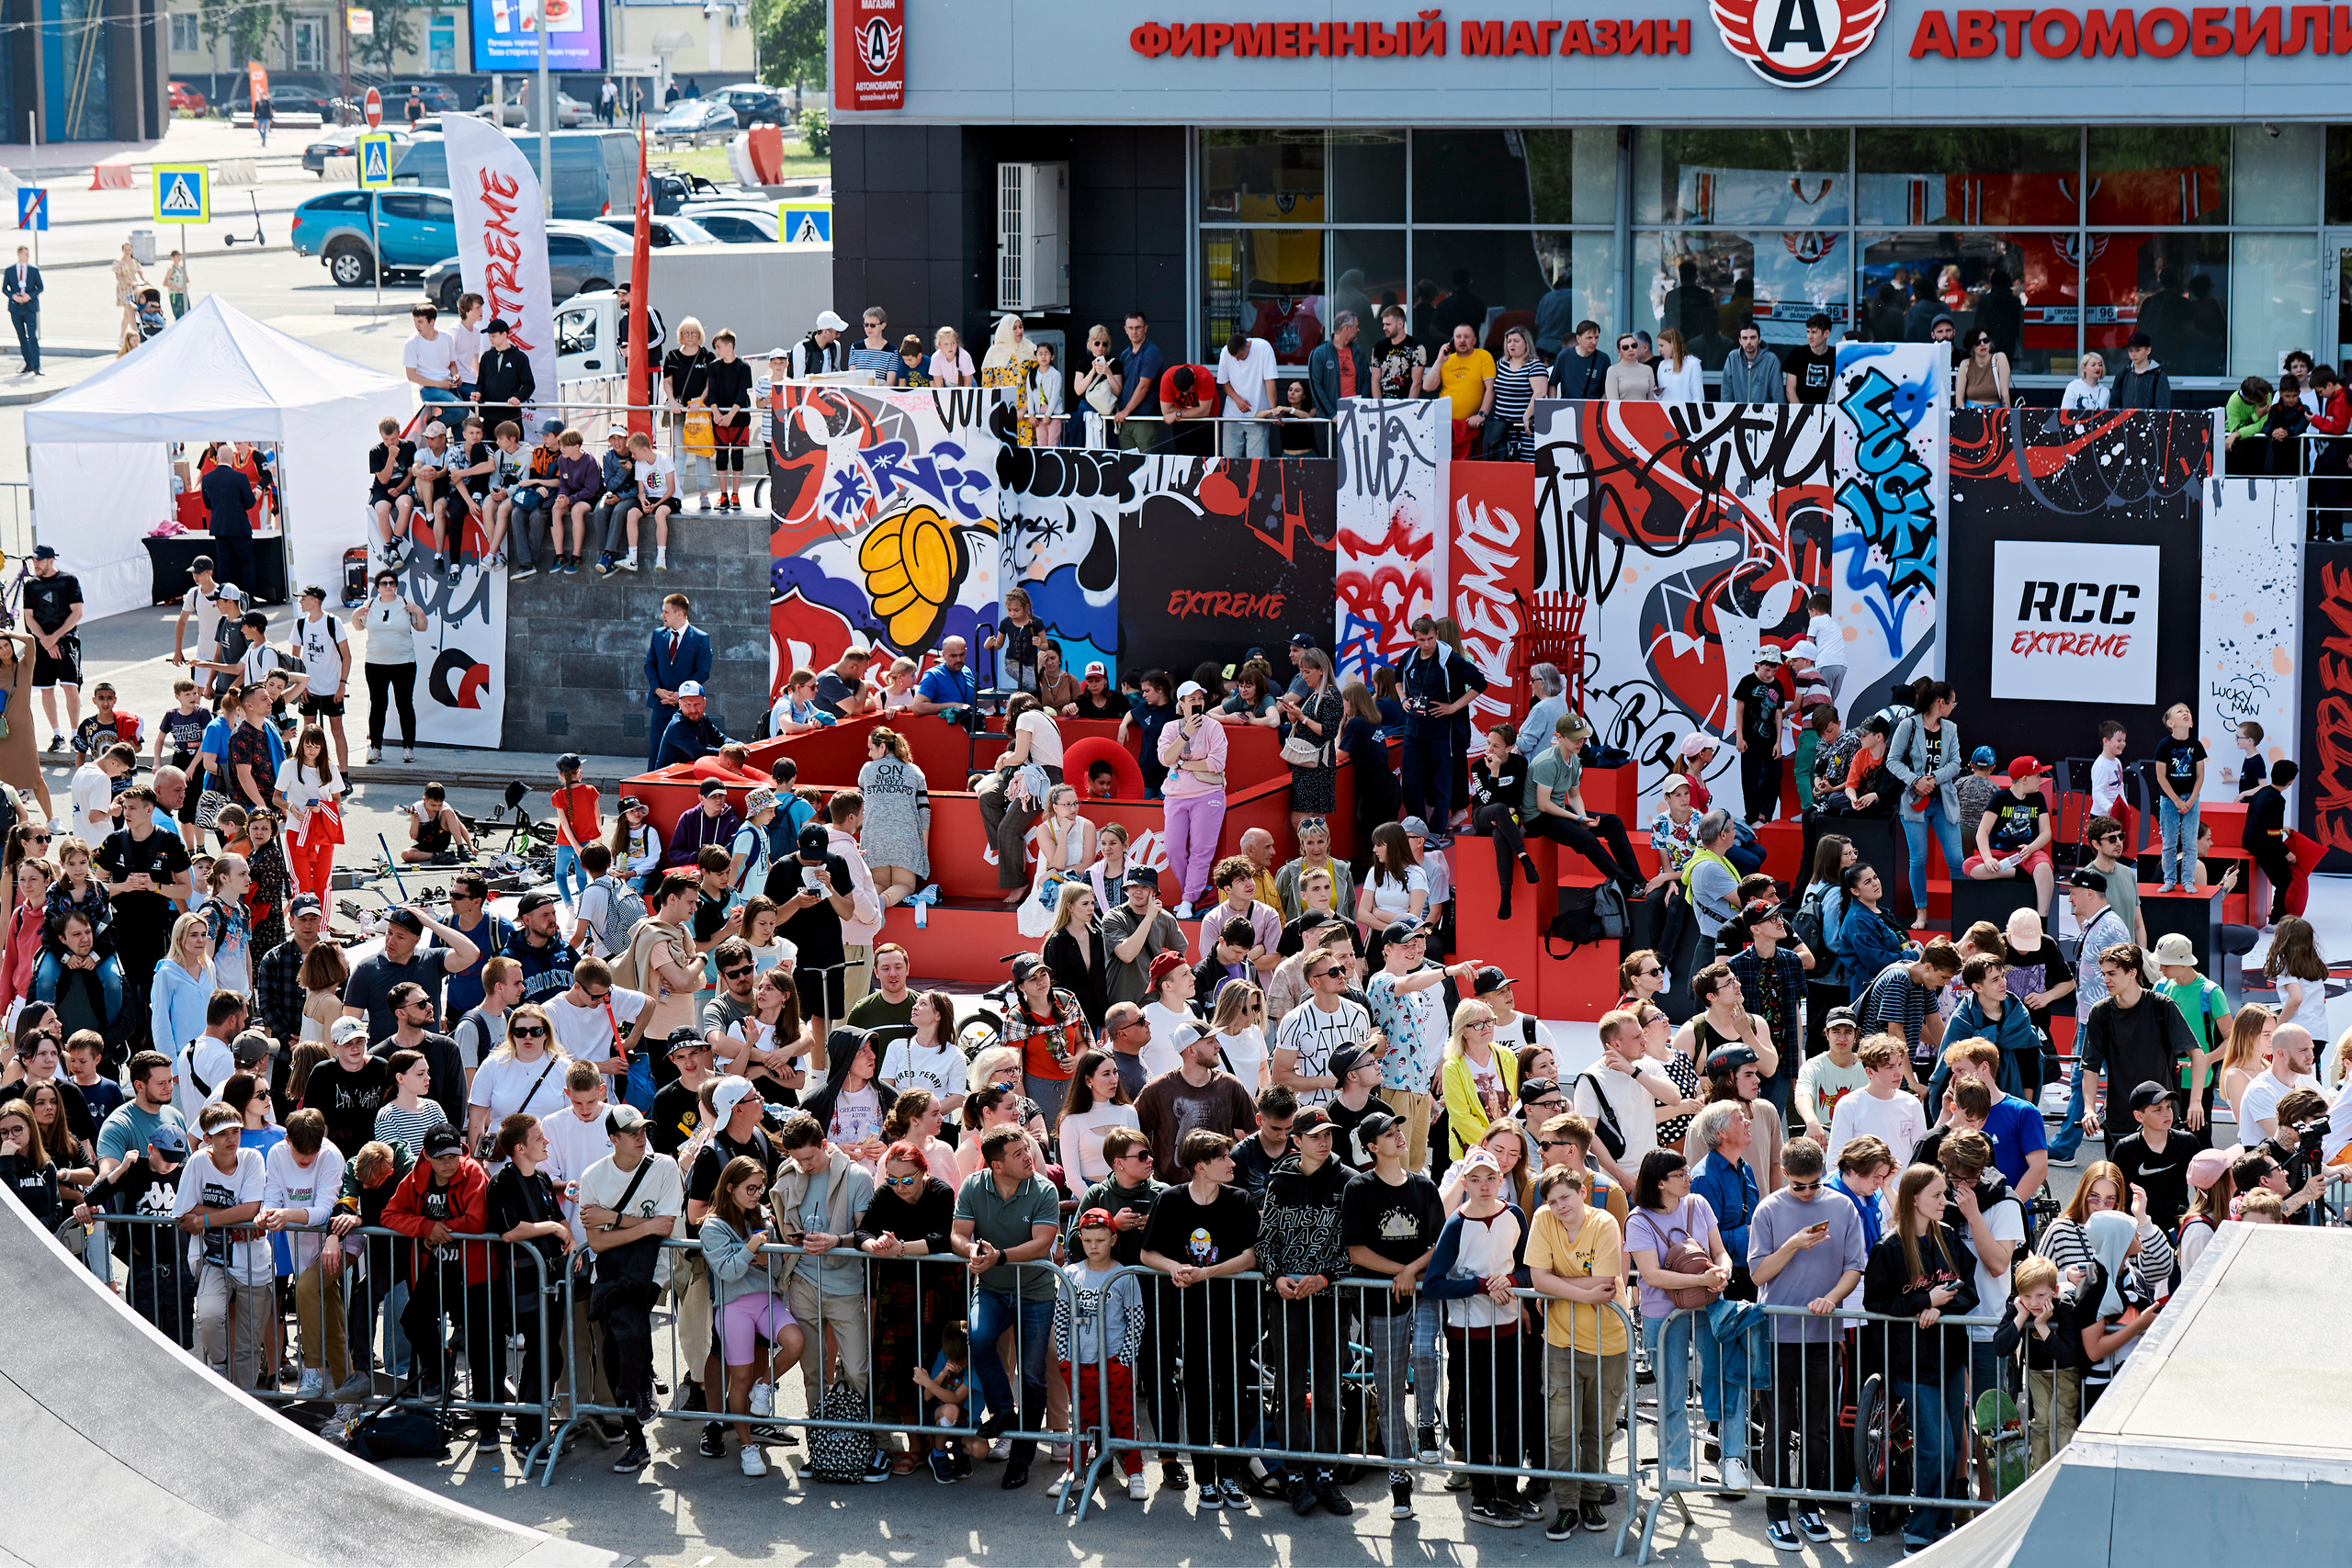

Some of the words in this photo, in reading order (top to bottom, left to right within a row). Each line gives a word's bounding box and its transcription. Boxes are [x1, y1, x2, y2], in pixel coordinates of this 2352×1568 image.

[1130, 9, 1446, 58] ФИРМЕННЫЙ
[1461, 18, 1690, 57] МАГАЗИН
[855, 81, 903, 92] АВТОМОБИЛИСТ
[859, 92, 886, 101] хоккейный
[887, 92, 899, 102] клуб
[2098, 308, 2115, 319] 96
[1167, 590, 1285, 620] EXTREME
[2018, 581, 2142, 626] RCC
[2009, 630, 2132, 659] EXTREME
[2211, 681, 2253, 705] LUCKY
[2232, 702, 2260, 716] MAN
[877, 764, 904, 775] ON
[866, 784, 914, 795] STANDARD
[2001, 806, 2039, 818] AWME
[895, 1070, 916, 1084] FRED
[919, 1069, 944, 1089] PERRY
